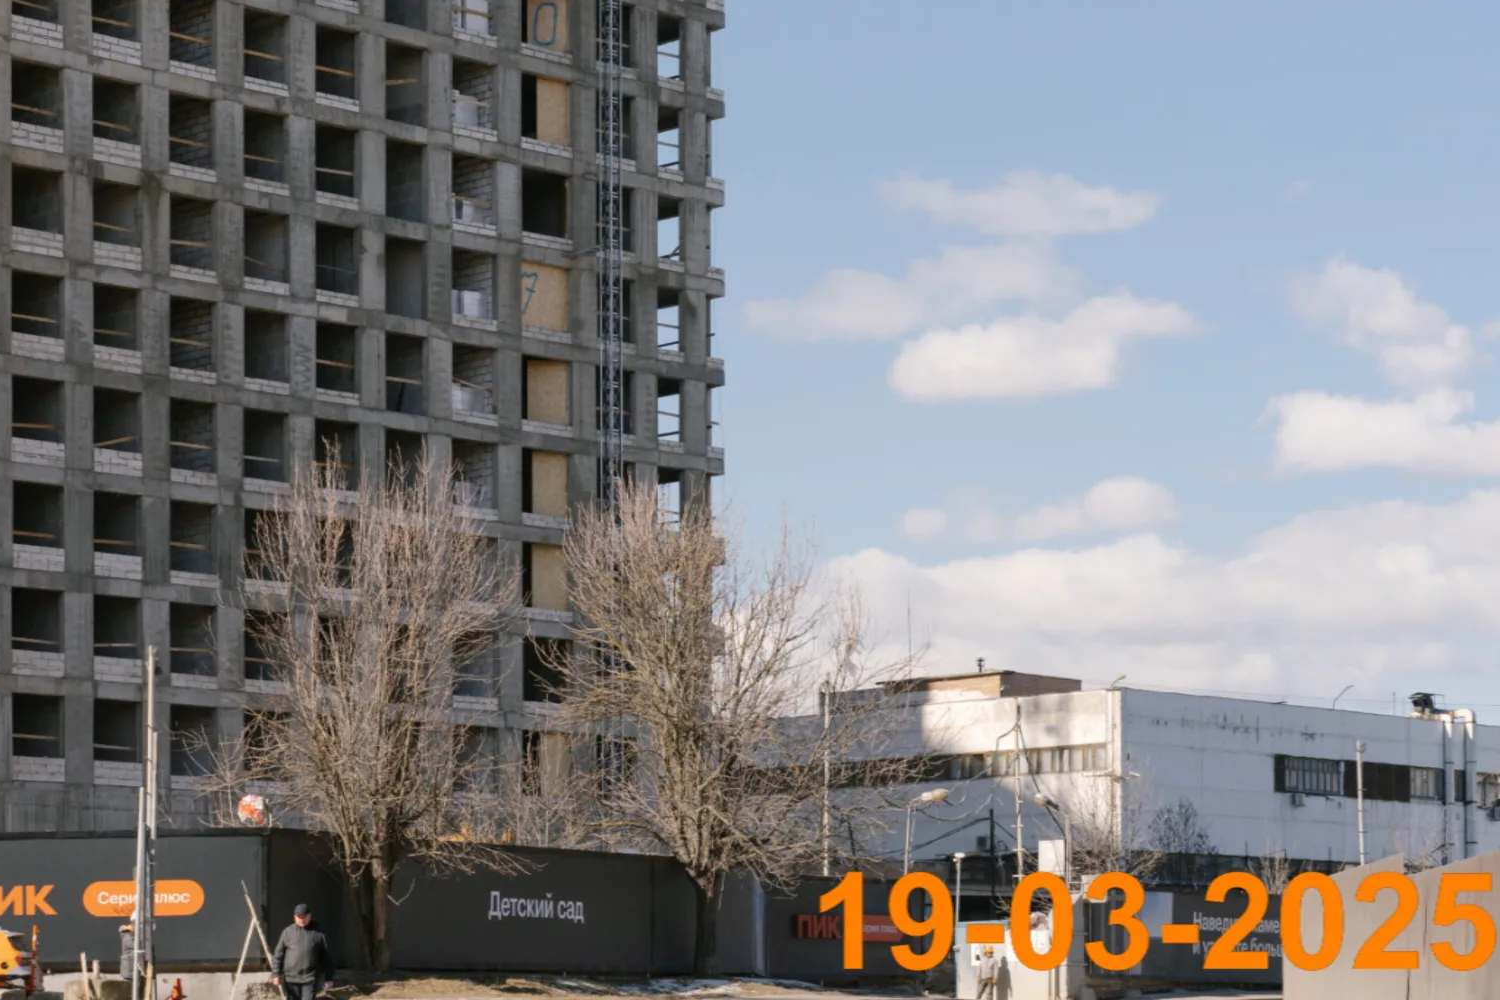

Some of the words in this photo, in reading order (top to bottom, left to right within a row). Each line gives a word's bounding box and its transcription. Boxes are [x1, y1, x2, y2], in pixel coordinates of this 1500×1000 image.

[533, 2, 557, 46] 0
[97, 891, 138, 907] Сери
[488, 890, 554, 920] Детский
[557, 900, 585, 924] сад
[796, 914, 842, 940] ПИК
